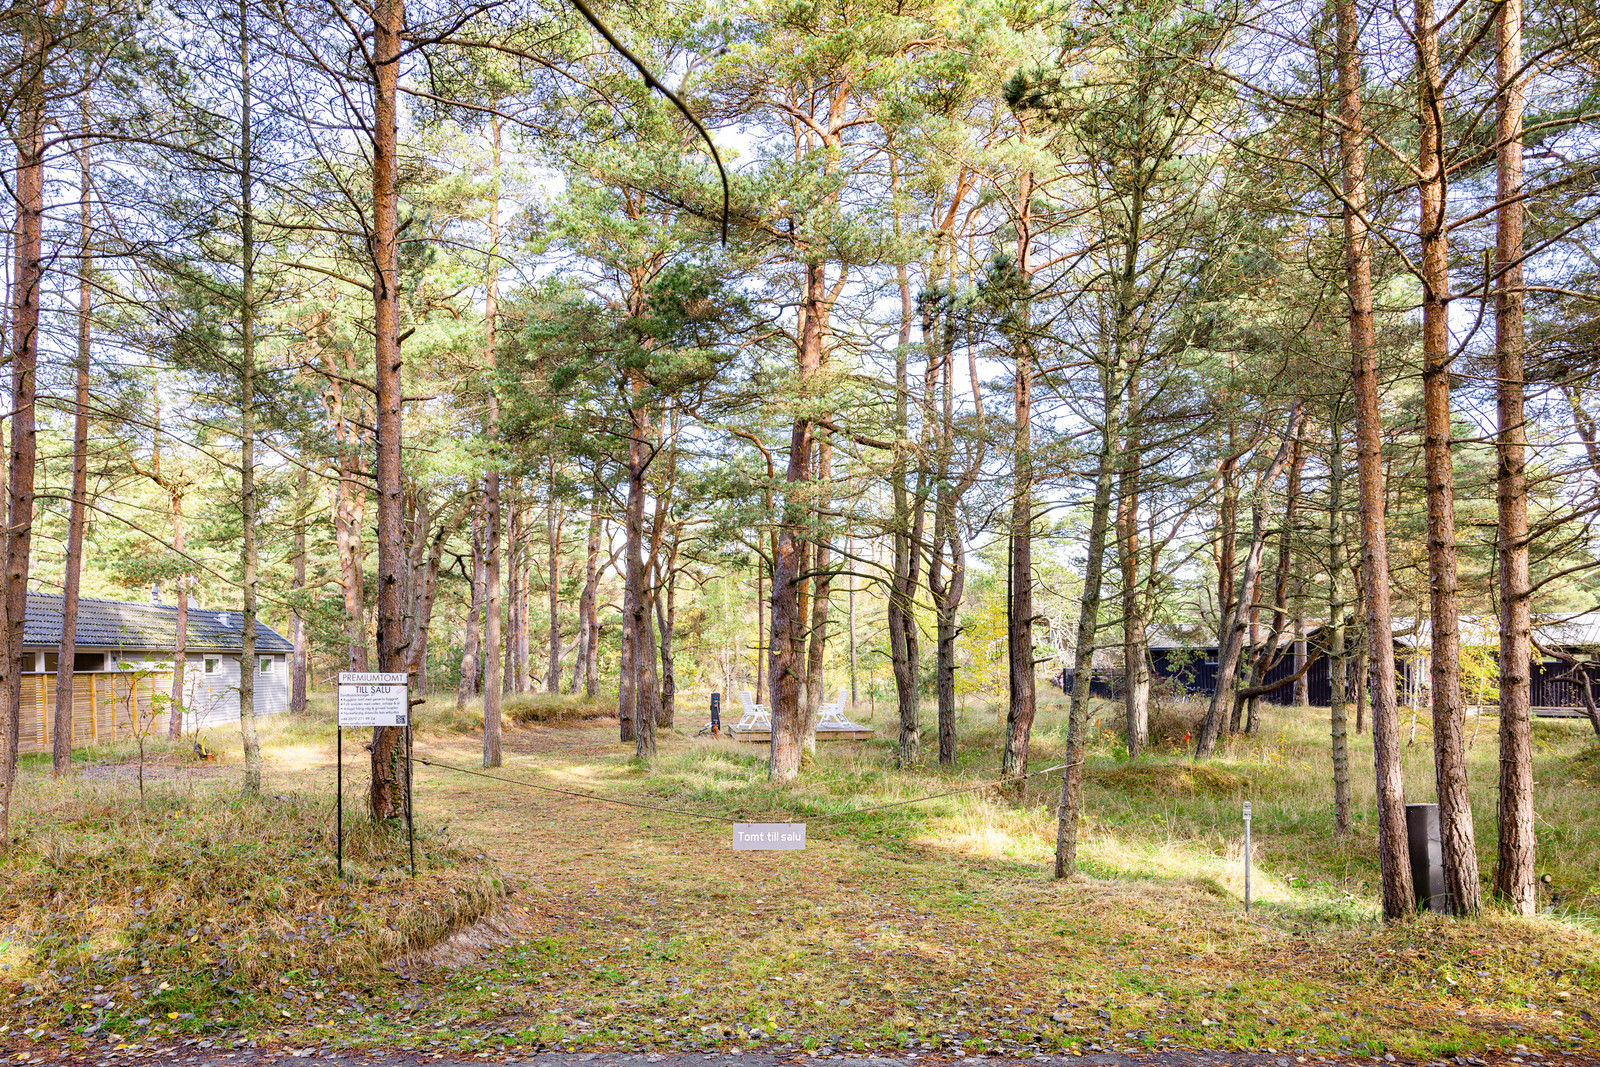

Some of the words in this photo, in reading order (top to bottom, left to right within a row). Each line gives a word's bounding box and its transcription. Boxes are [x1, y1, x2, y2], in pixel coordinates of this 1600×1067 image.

[738, 832, 764, 842] Tomt
[767, 832, 779, 842] till
[781, 832, 801, 842] salu
